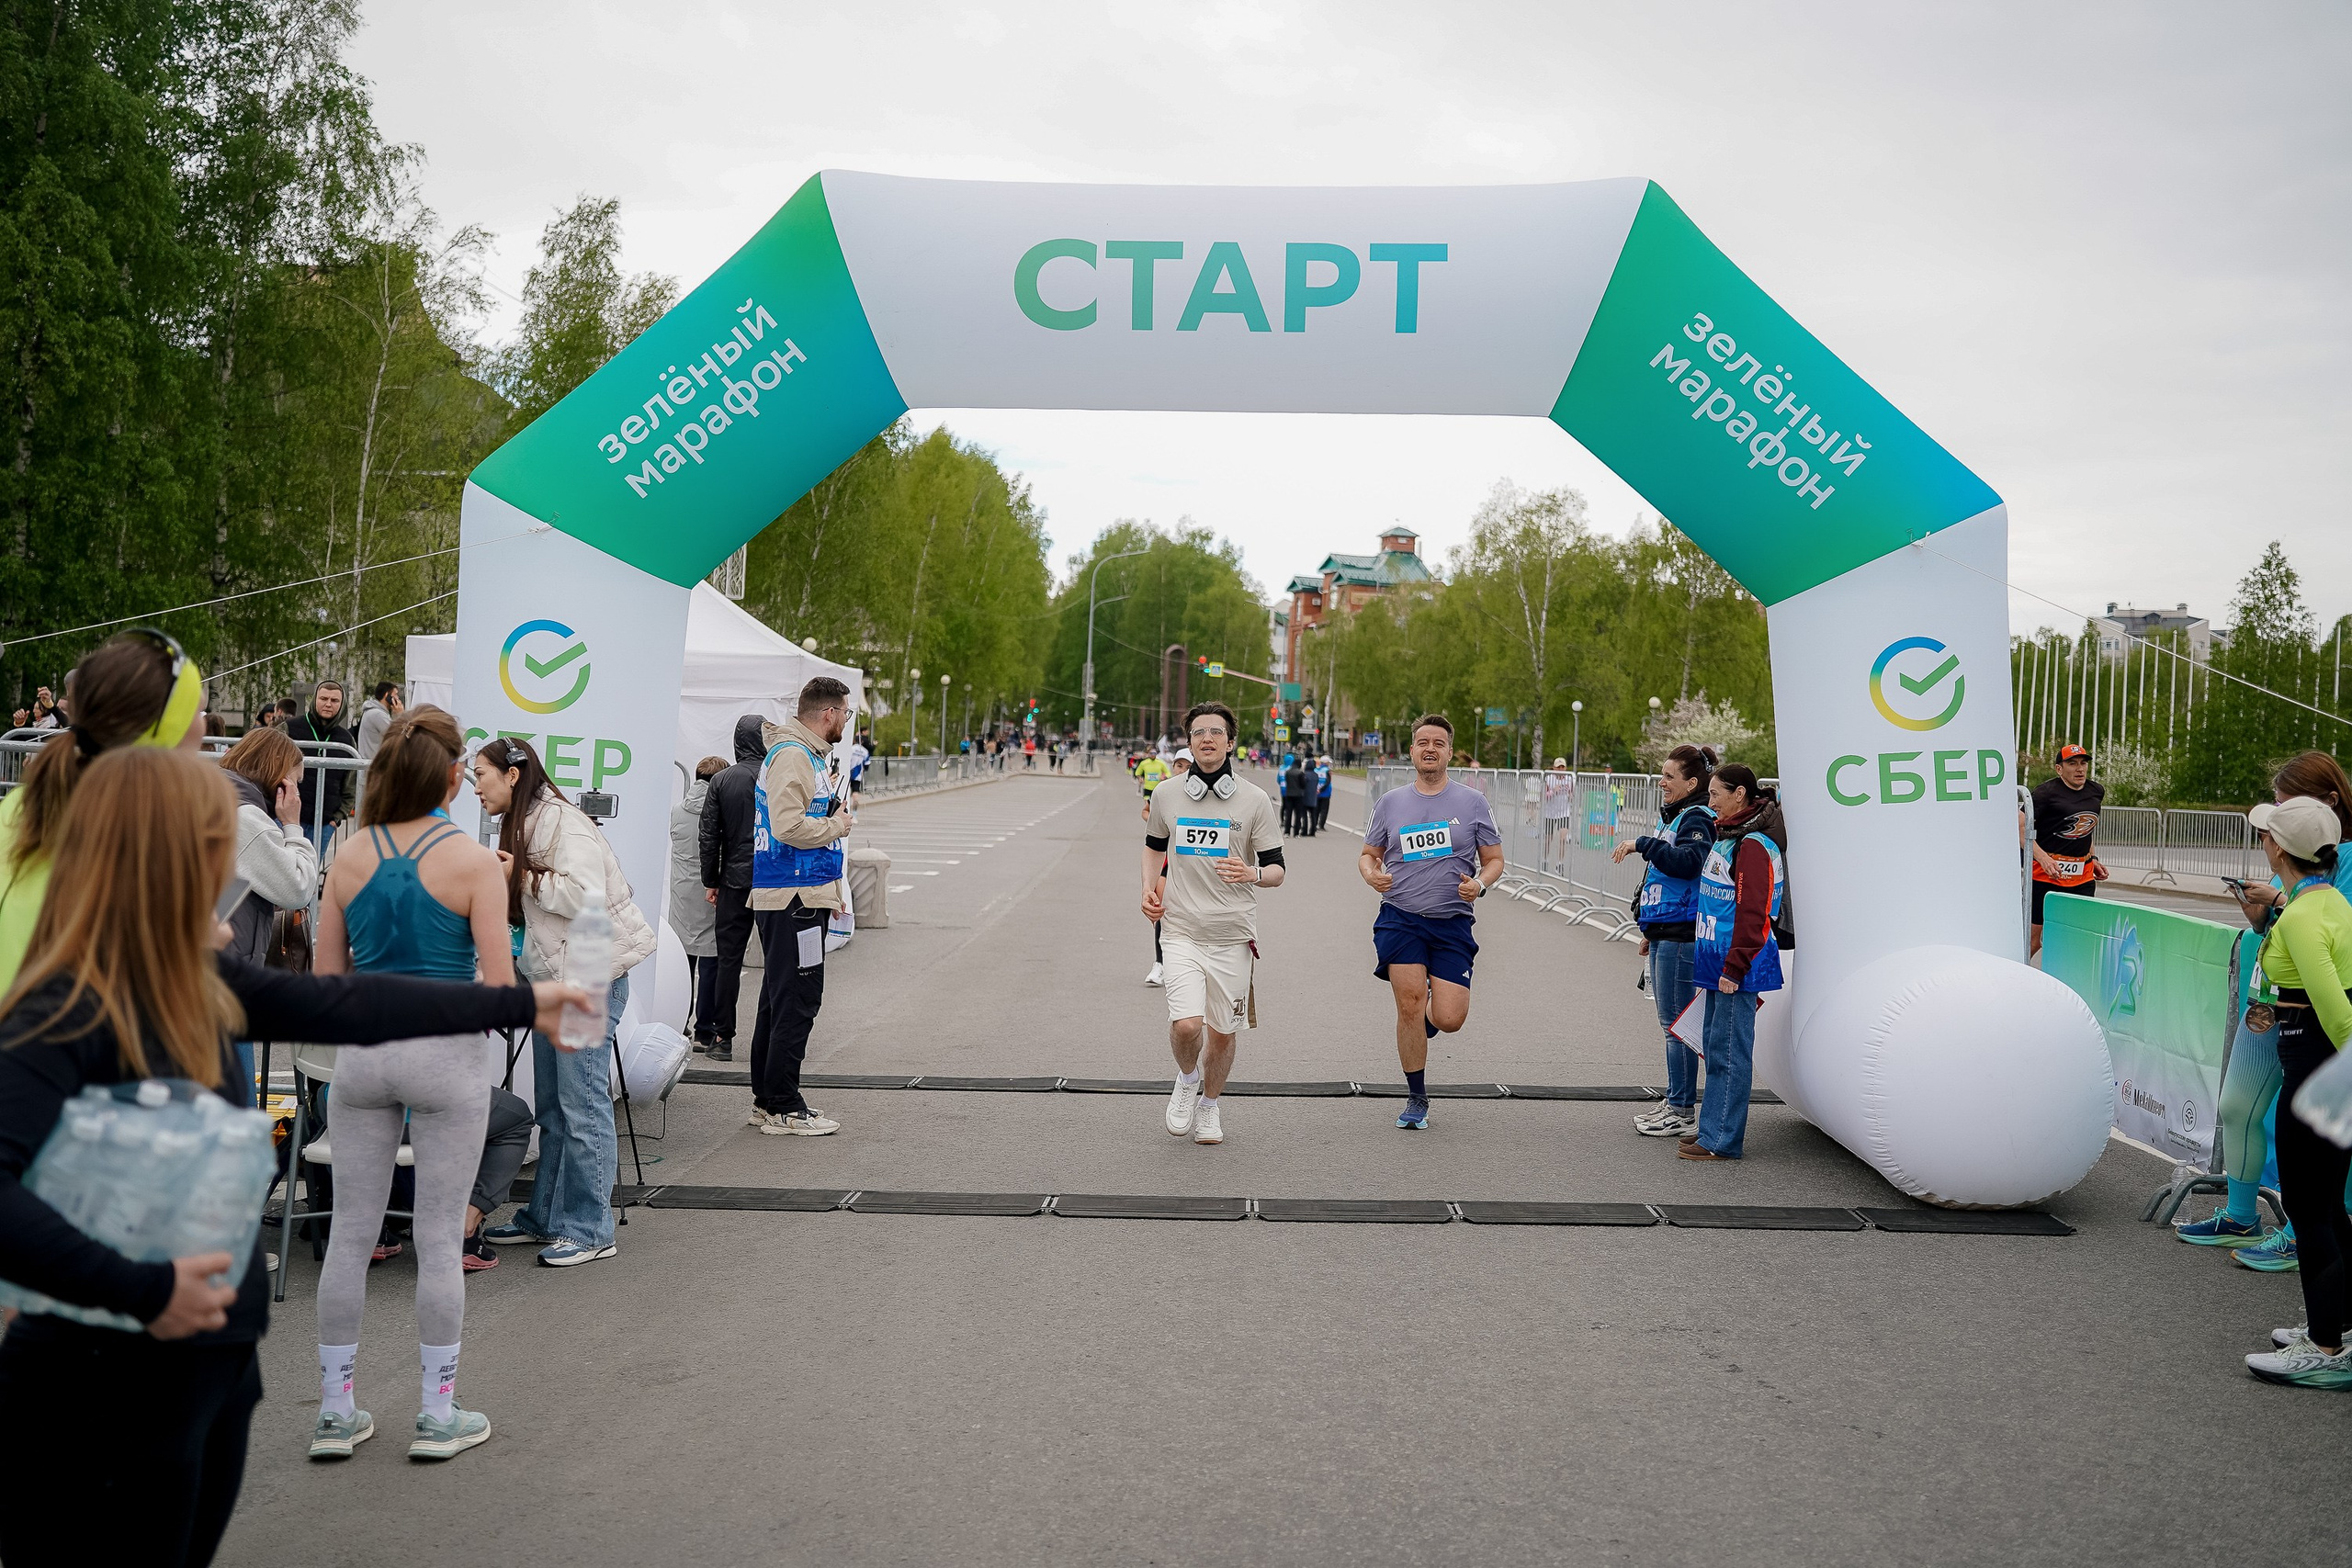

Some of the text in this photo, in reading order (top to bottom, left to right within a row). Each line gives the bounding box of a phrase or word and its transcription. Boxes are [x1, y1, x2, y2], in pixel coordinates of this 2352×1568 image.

[1013, 237, 1449, 334] СТАРТ
[597, 297, 778, 464] зелёный
[624, 337, 808, 499] марафон
[1682, 312, 1872, 477] зелёный
[1649, 342, 1836, 510] марафон
[1826, 749, 2006, 807] СБЕР
[1186, 829, 1218, 845] 579
[1406, 830, 1446, 850] 1080
[1711, 886, 1736, 902] РОССИЯ
[1736, 872, 1745, 905] SALOMON
